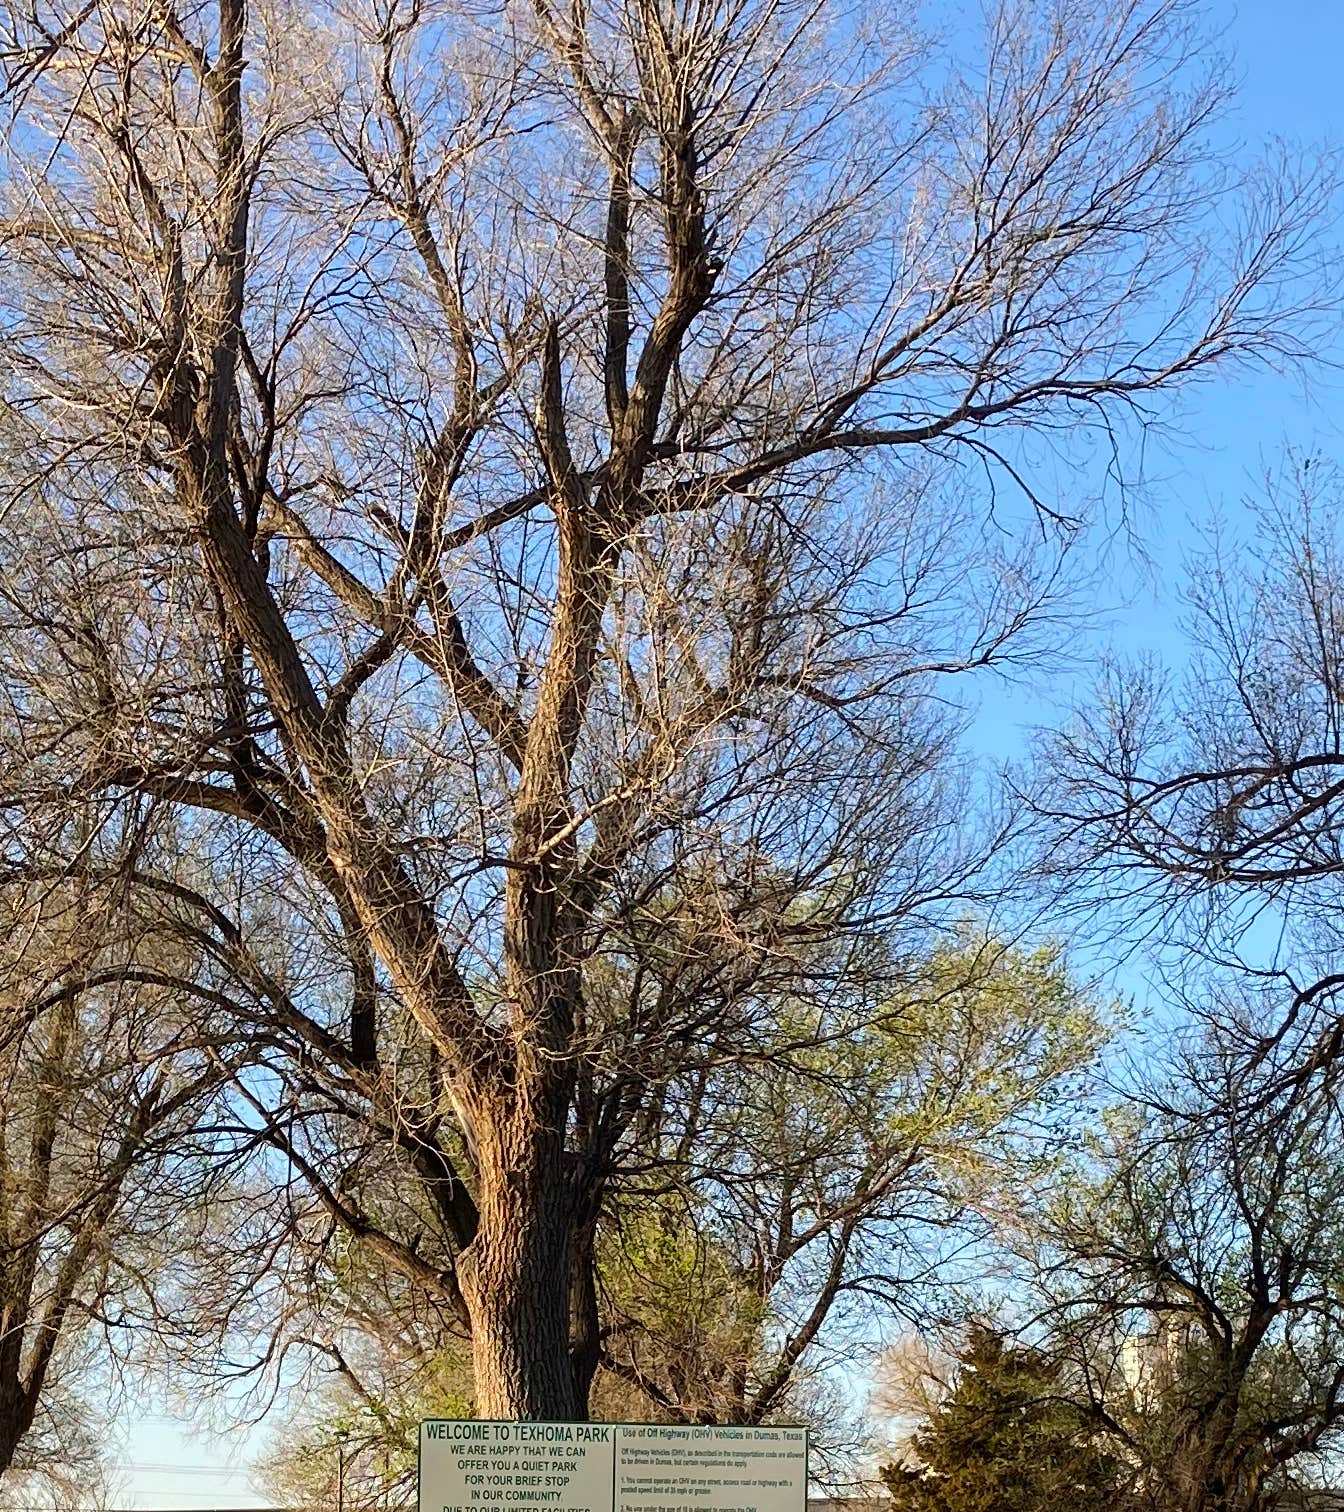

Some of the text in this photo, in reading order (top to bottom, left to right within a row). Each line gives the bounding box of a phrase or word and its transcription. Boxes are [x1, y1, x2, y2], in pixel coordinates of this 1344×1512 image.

[426, 1424, 609, 1442] WELCOME TO TEXHOMA PARK
[622, 1428, 636, 1438] Use
[637, 1428, 646, 1438] of
[646, 1428, 658, 1438] Off
[659, 1429, 690, 1440] Highway
[714, 1430, 744, 1440] Vehicles
[745, 1430, 752, 1440] in
[782, 1431, 802, 1441] Texas
[450, 1445, 586, 1456] WE ARE HAPPY THAT WE CAN
[458, 1461, 577, 1471] OFFER YOU A QUIET PARK
[464, 1475, 570, 1486] FOR YOUR BRIEF STOP
[470, 1490, 480, 1500] IN
[482, 1491, 503, 1500] OUR
